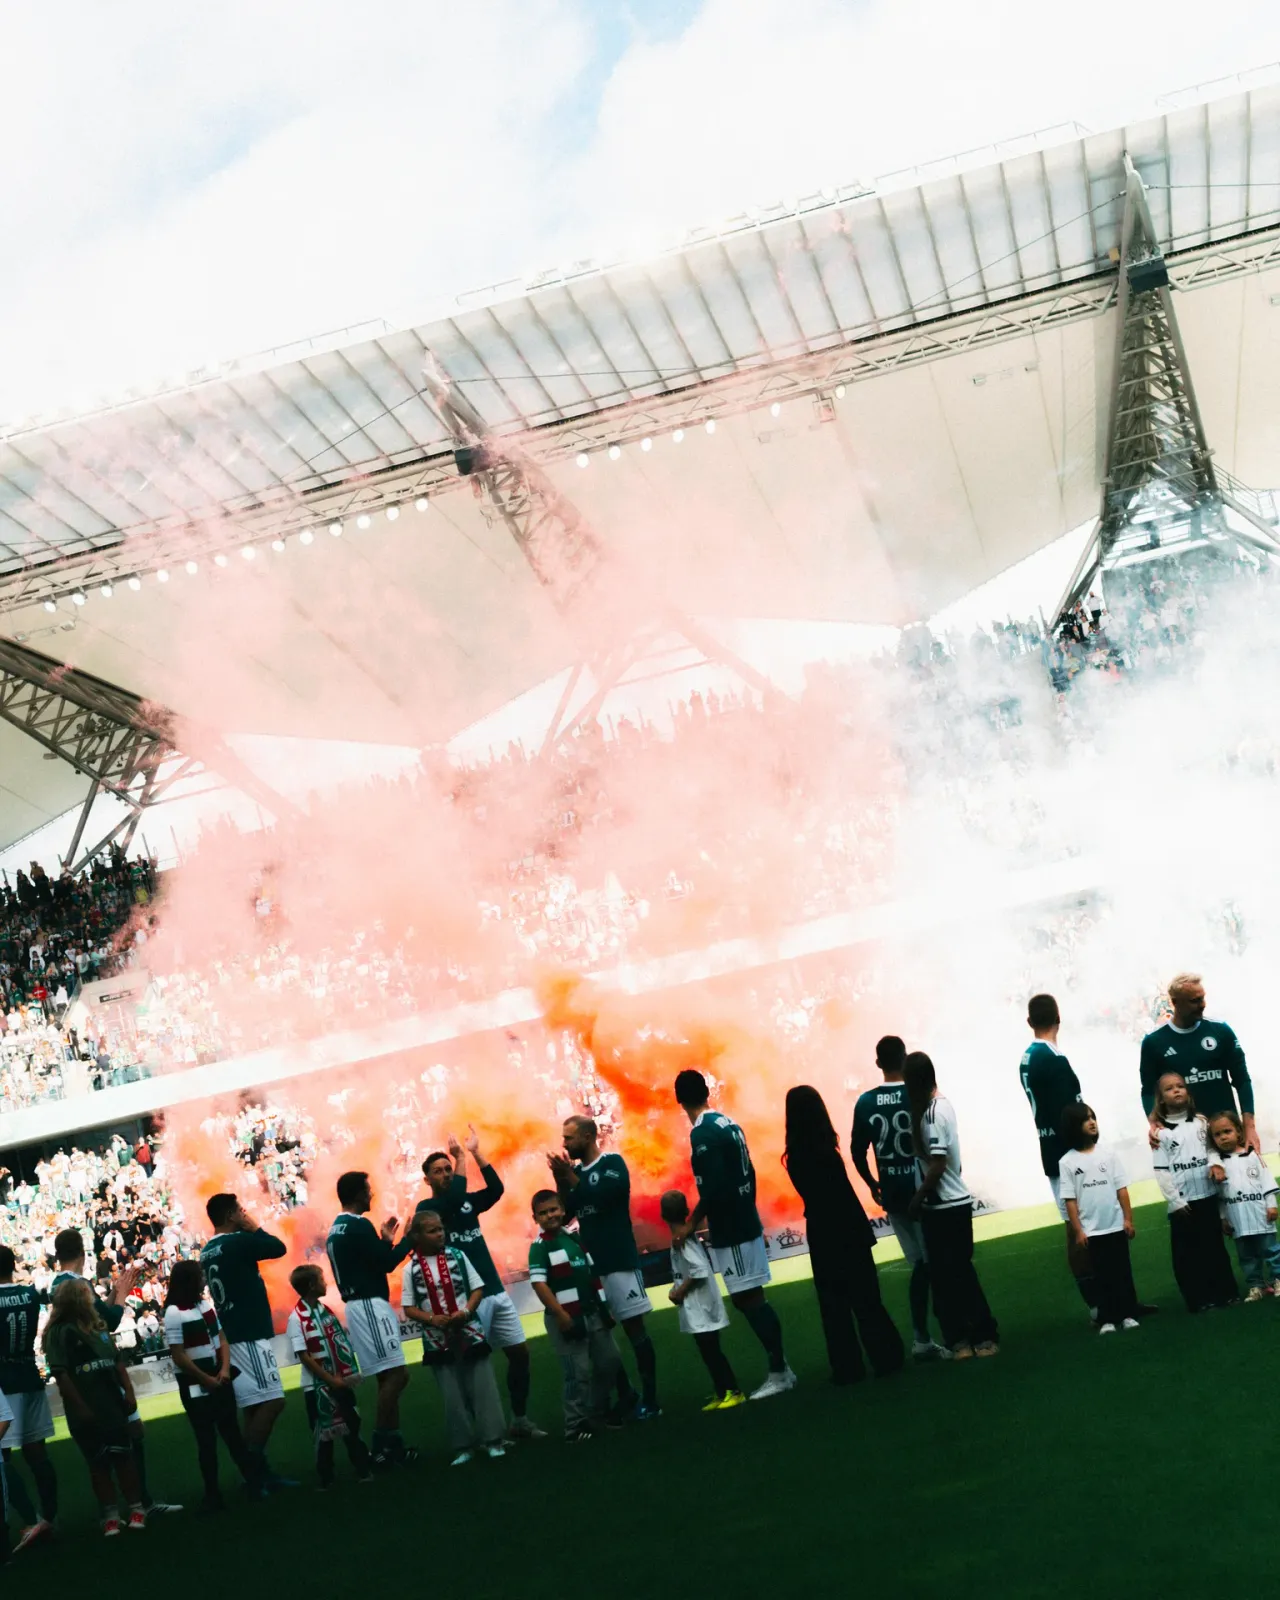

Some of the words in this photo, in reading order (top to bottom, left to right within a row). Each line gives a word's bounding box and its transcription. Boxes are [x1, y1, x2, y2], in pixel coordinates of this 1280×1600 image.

[868, 1110, 917, 1159] 28
[6, 1311, 28, 1354] 11
[381, 1317, 395, 1336] 11
[262, 1350, 278, 1369] 16
